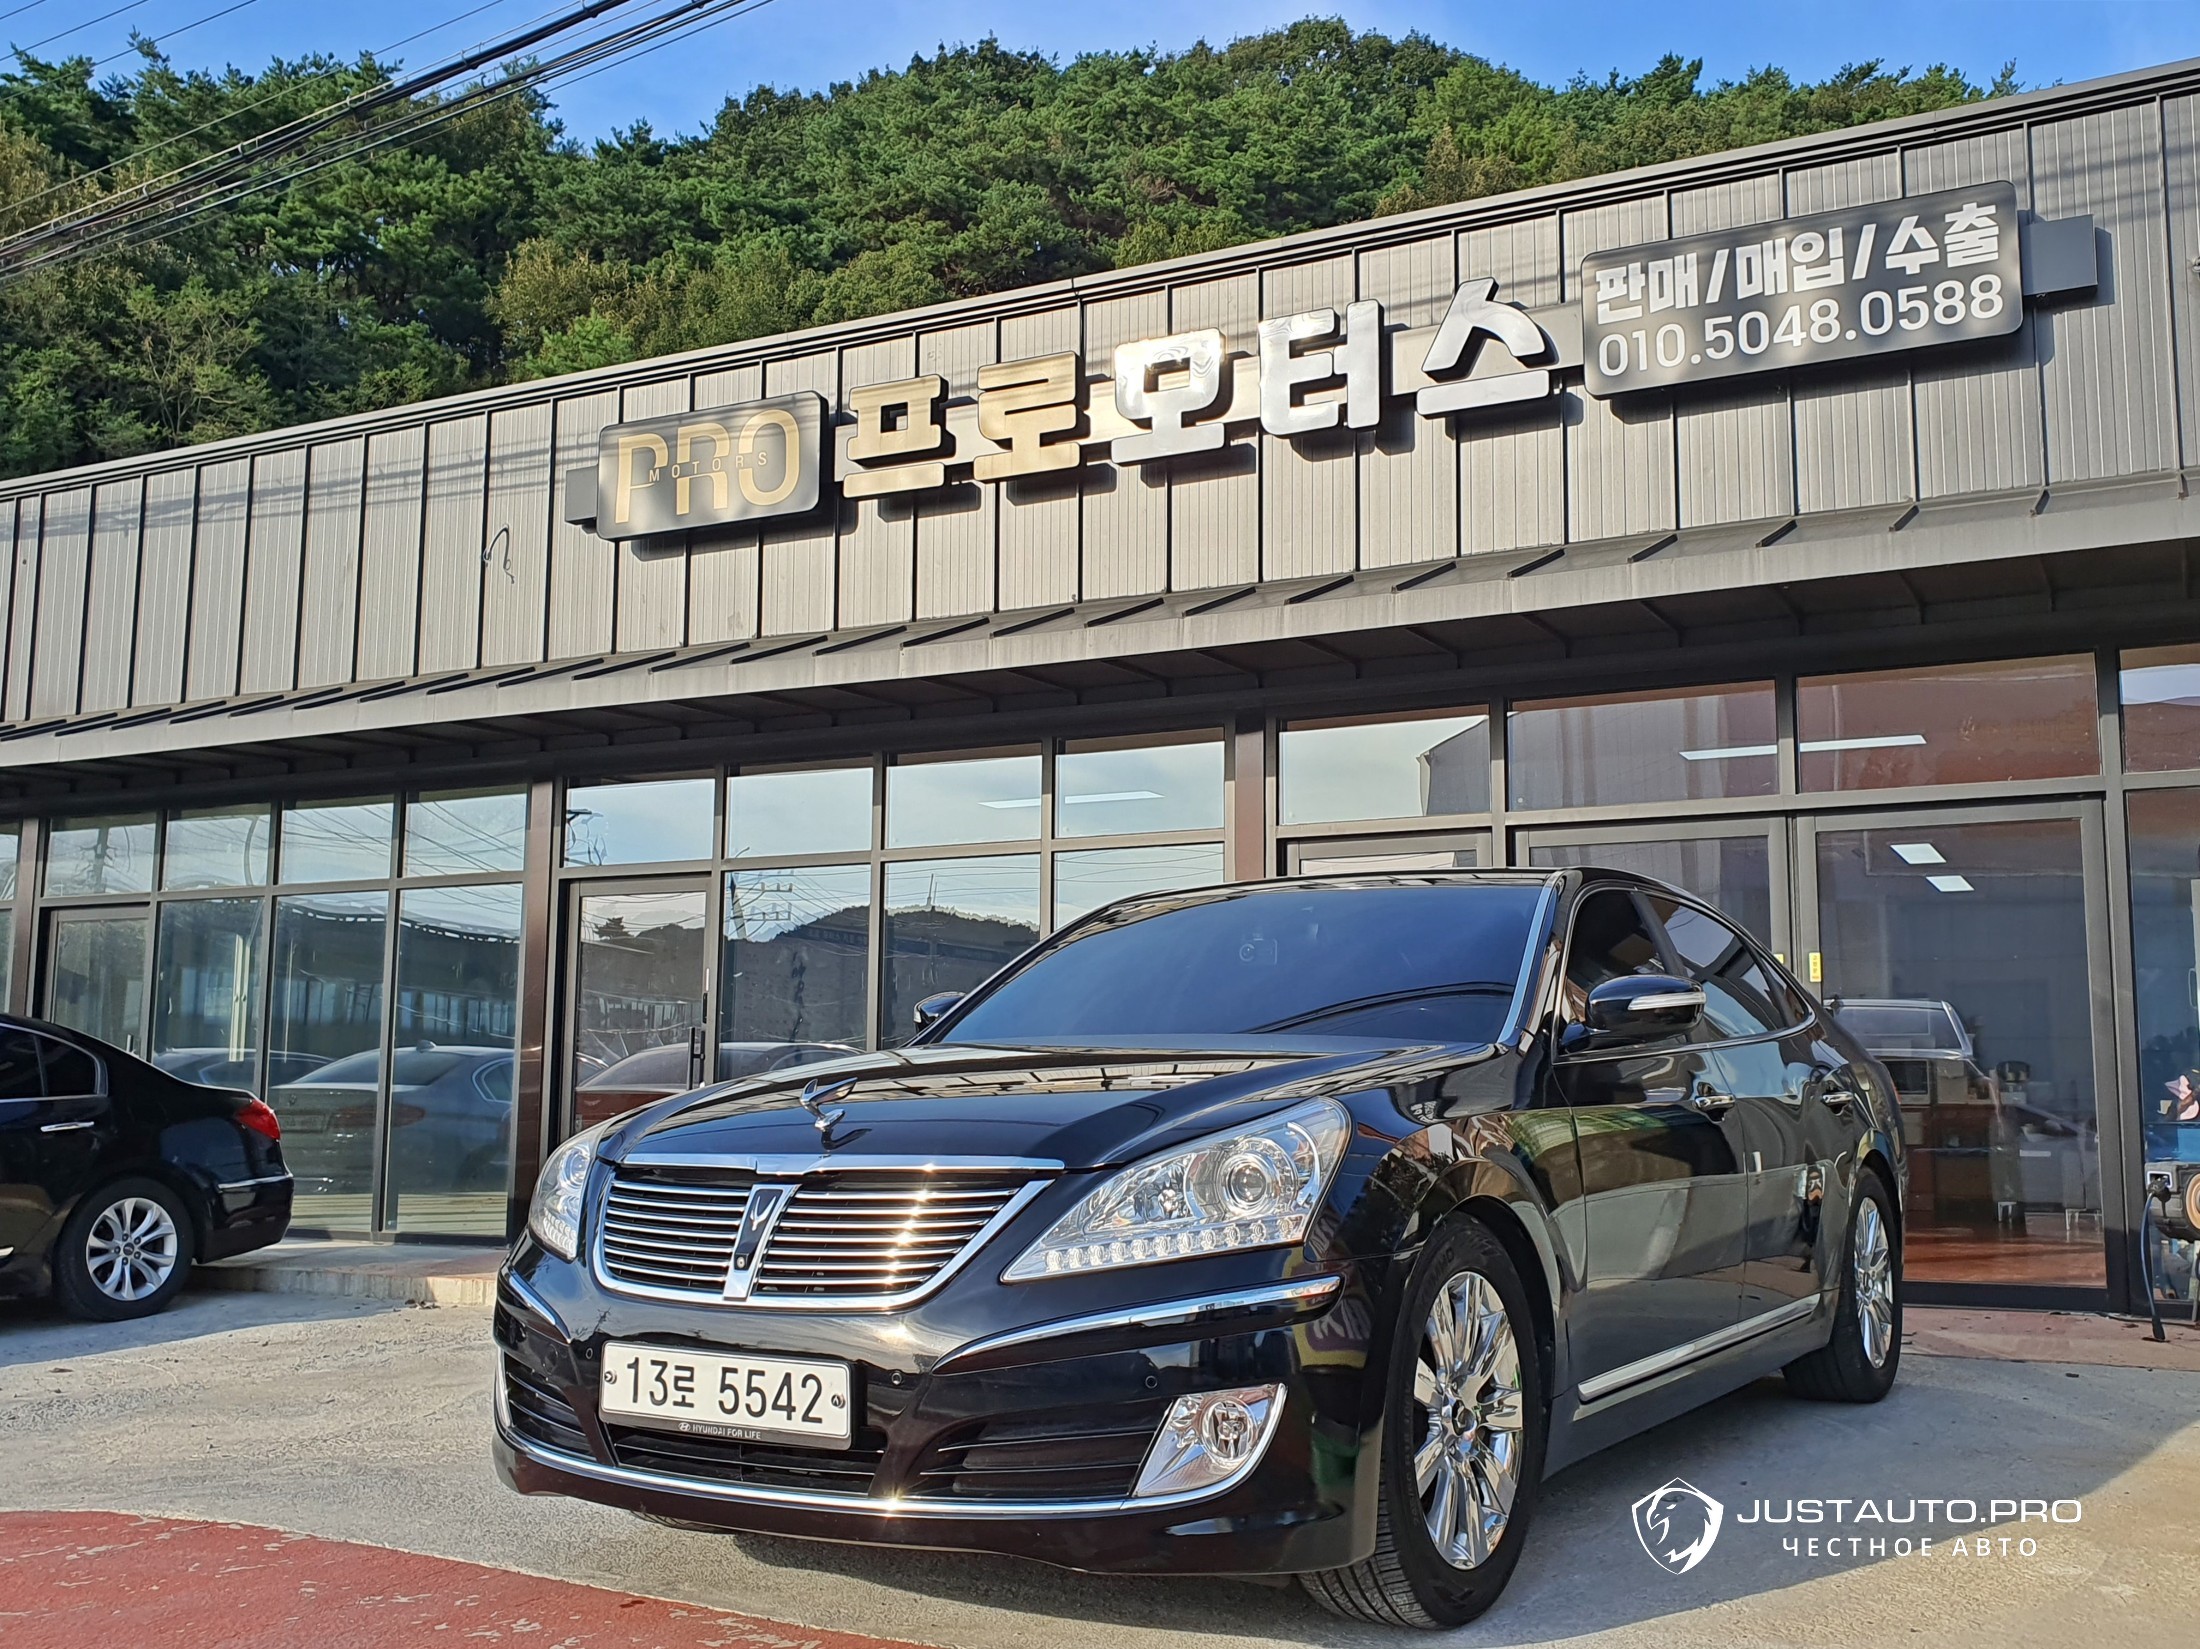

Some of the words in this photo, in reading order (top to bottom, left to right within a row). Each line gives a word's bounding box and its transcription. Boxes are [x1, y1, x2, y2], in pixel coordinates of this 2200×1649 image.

[1598, 273, 2004, 377] 010.5048.0588
[843, 276, 1550, 498] 프로모터스
[615, 409, 800, 524] PRO
[649, 451, 768, 483] MOTORS
[626, 1356, 695, 1409] 13로
[718, 1366, 823, 1424] 5542
[692, 1423, 726, 1436] HYUNDAI
[727, 1428, 743, 1438] FOR
[744, 1430, 762, 1440] LIFE
